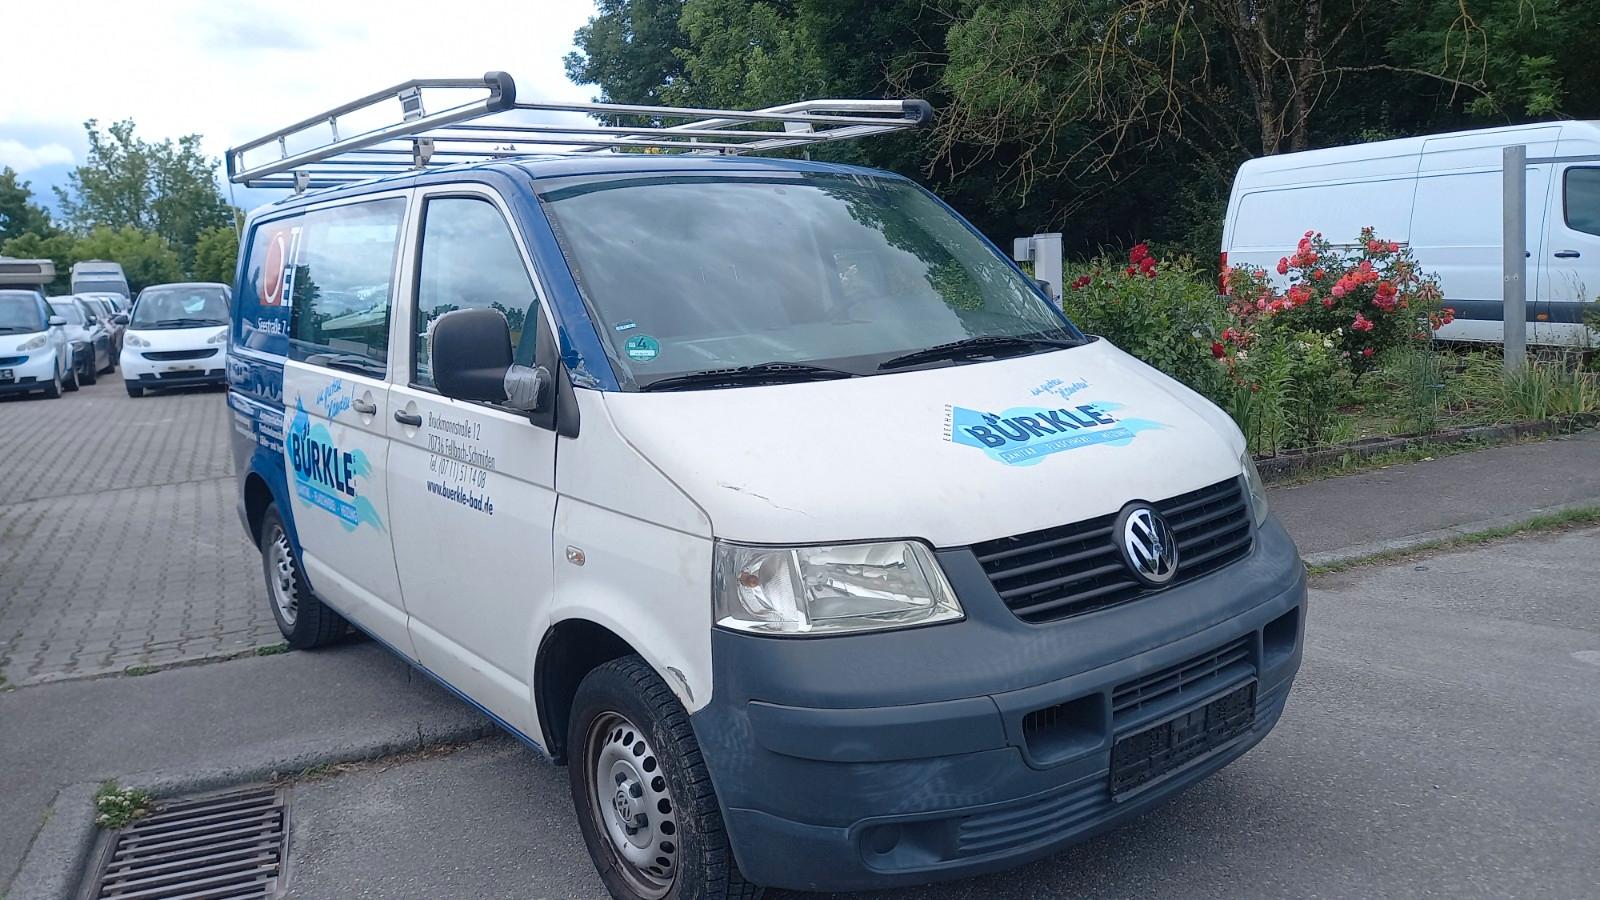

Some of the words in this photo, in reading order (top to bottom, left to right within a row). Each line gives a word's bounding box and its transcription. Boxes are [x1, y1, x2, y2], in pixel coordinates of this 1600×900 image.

[473, 422, 481, 441] 12
[964, 404, 1115, 448] BÜRKLE
[292, 419, 355, 497] BÜRKLE
[428, 433, 444, 454] 70736
[445, 437, 496, 469] Fellbach-Schmiden
[430, 454, 438, 472] Tel.
[427, 480, 494, 516] www.buerkle-bad.de
